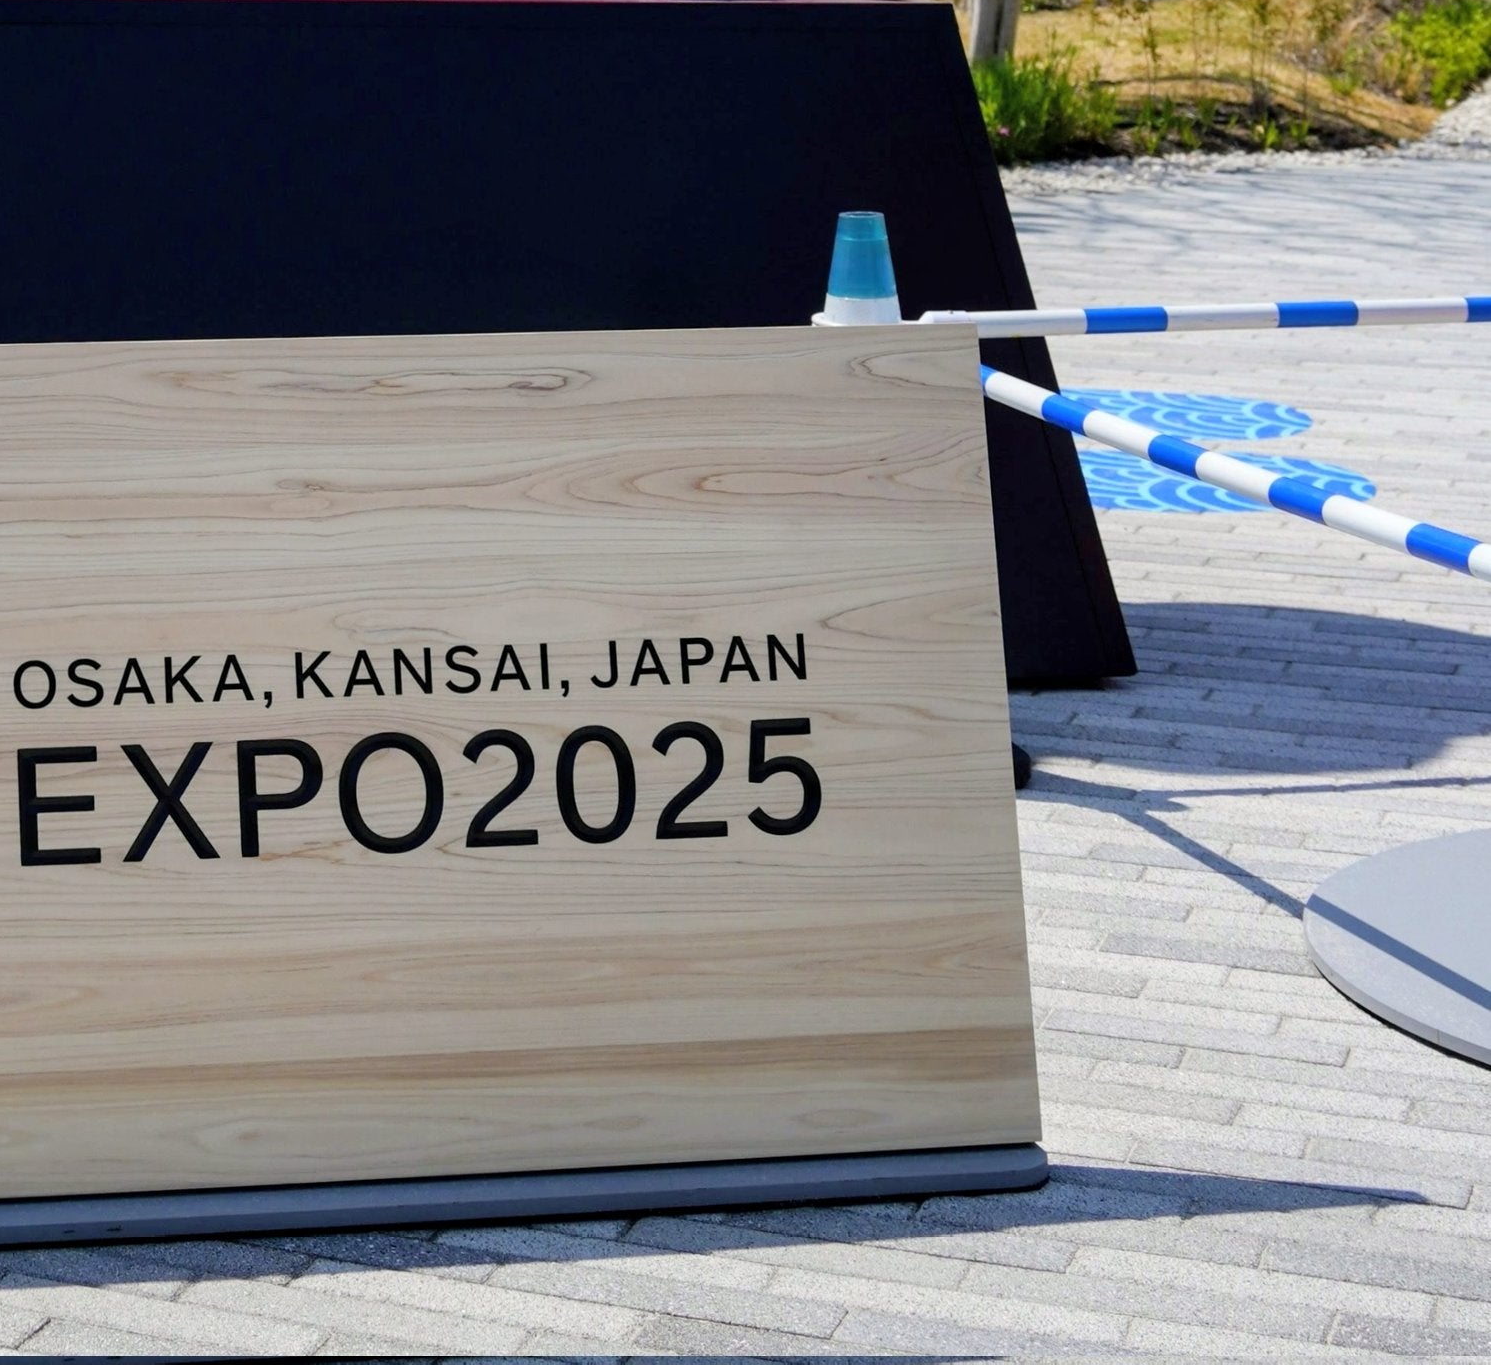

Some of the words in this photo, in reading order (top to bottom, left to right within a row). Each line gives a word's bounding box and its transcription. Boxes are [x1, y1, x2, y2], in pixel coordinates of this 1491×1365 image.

[13, 654, 273, 710] OSAKA,
[294, 642, 570, 699] KANSAI,
[590, 633, 807, 689] JAPAN
[16, 717, 822, 867] EXPO2025
